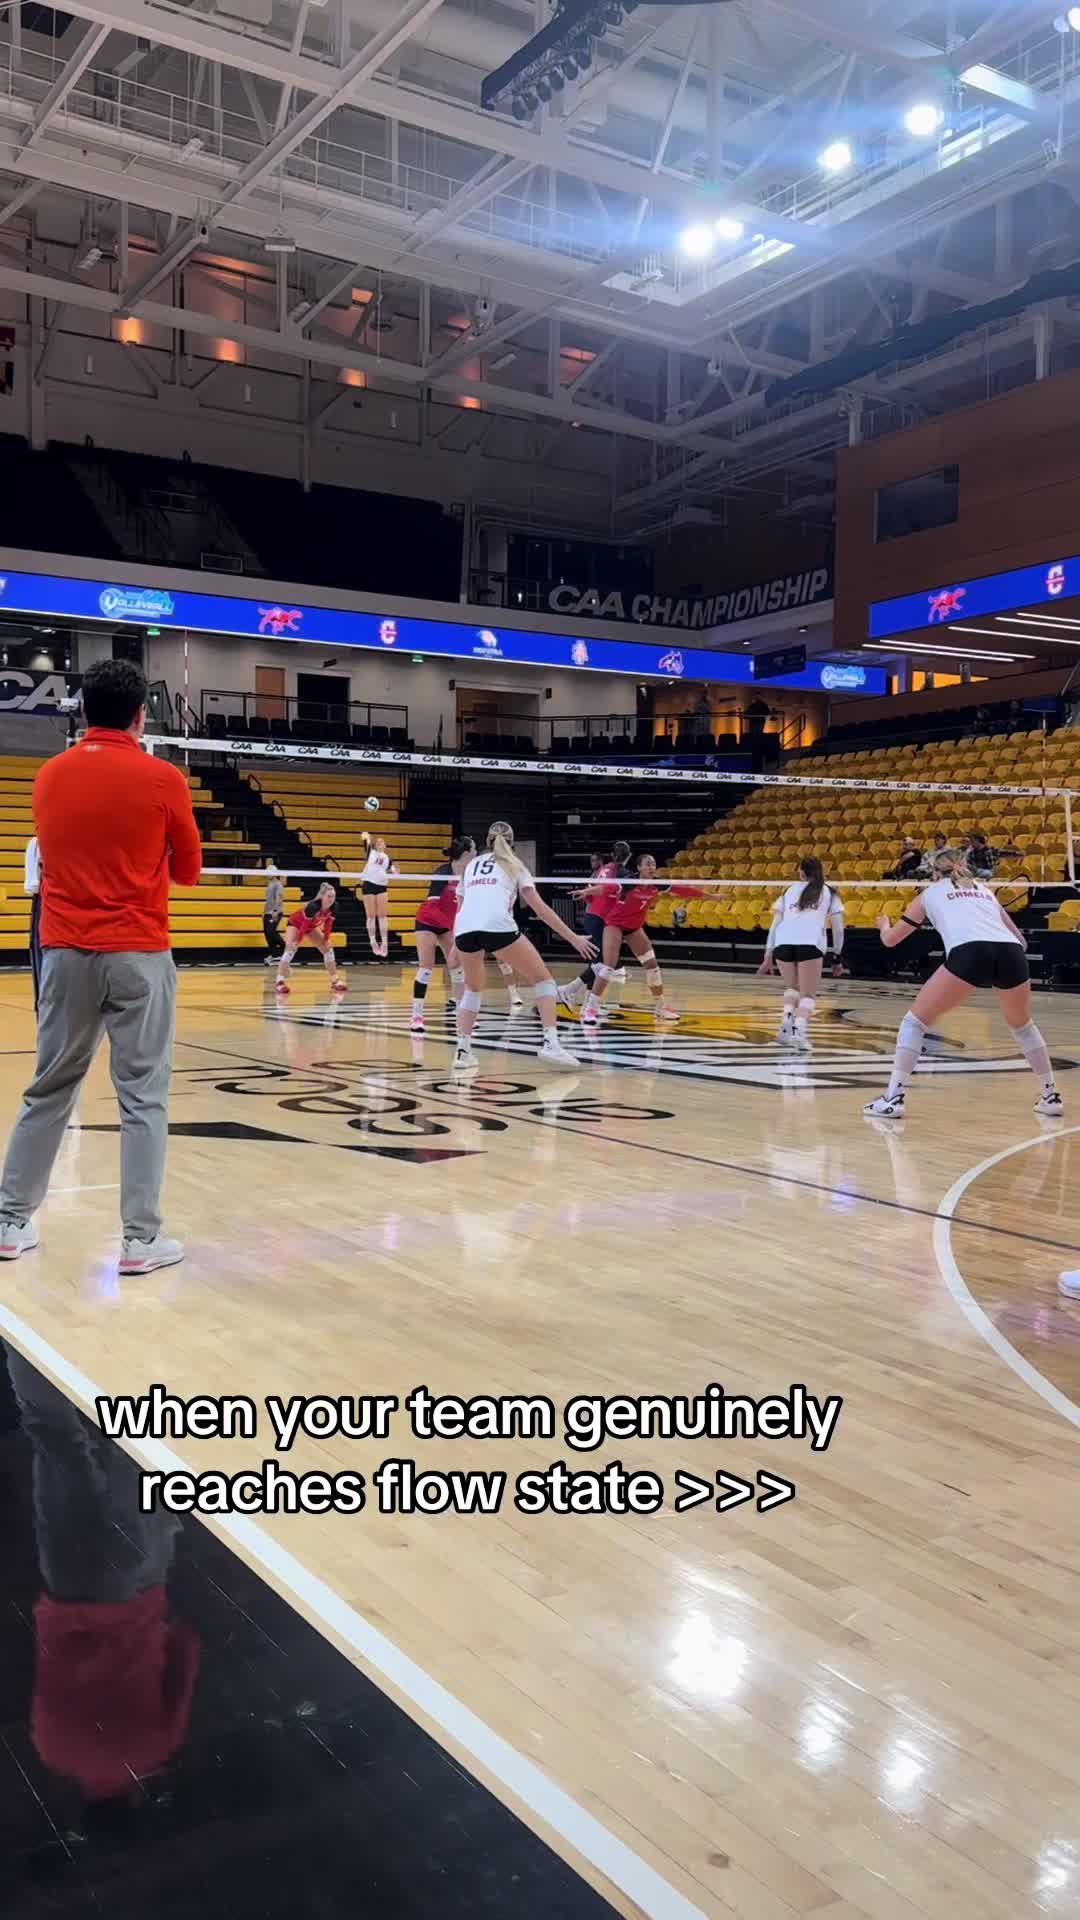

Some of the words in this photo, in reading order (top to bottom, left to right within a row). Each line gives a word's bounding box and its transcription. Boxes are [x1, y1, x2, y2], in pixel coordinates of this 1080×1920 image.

[549, 585, 625, 618] CAA
[631, 568, 828, 627] CHAMPIONSHIP
[0, 671, 84, 713] CA
[231, 742, 252, 751] CAA
[265, 744, 286, 753] CAA
[298, 747, 318, 755] CAA
[330, 749, 350, 757] CAA
[362, 751, 381, 760] CAA
[392, 753, 411, 761] CAA
[422, 755, 442, 763] CAA
[452, 757, 470, 765] CAA
[481, 759, 499, 767] CAA
[509, 761, 527, 769] CAA
[564, 764, 581, 772] CAA
[591, 766, 607, 774] CAA
[642, 768, 658, 777] CAA
[473, 860, 495, 876] 15
